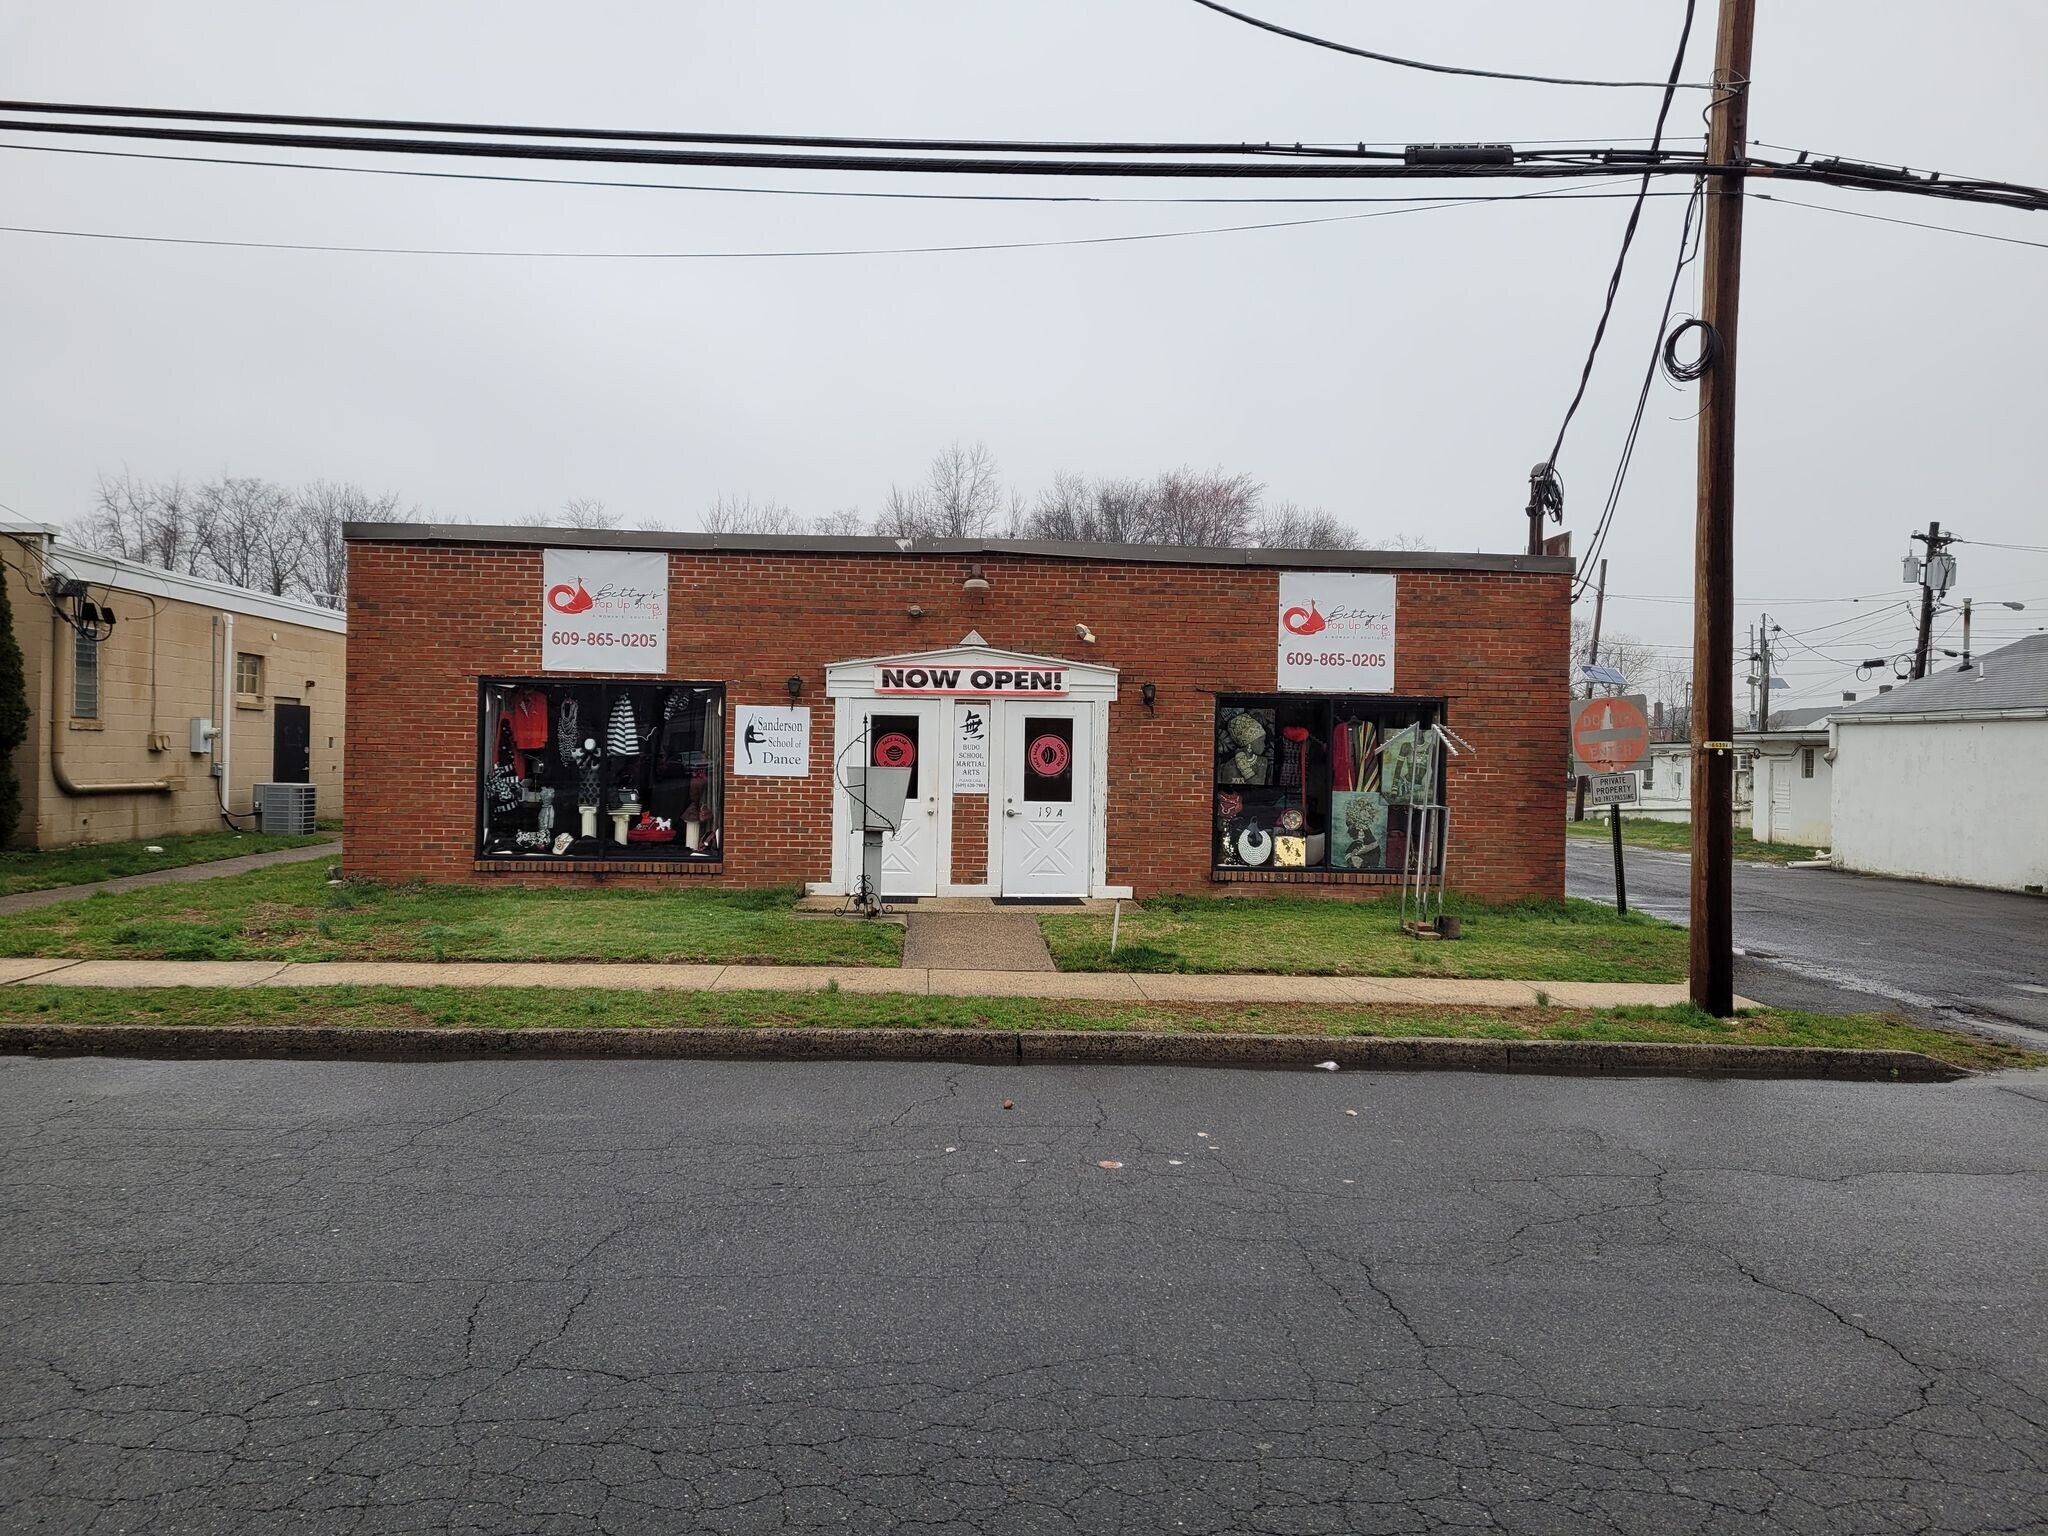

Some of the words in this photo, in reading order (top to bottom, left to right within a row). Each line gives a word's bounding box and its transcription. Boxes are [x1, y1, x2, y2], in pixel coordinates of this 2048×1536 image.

[592, 583, 663, 605] Betty's
[594, 598, 612, 613] Pop
[618, 598, 630, 613] Up
[635, 599, 660, 616] Shop
[1323, 605, 1392, 626] Betty's
[1328, 619, 1344, 635] Pop
[1348, 619, 1361, 635] Up
[1365, 621, 1388, 637] Shop
[551, 631, 658, 648] 609-865-0205
[1286, 652, 1386, 667] 609-865-0205
[881, 669, 961, 689] NOW
[970, 670, 1062, 691] OPEN!
[757, 716, 803, 732] Sanderson
[1583, 714, 1600, 727] DO
[767, 736, 794, 748] School
[794, 739, 802, 749] of
[762, 751, 802, 765] Dance
[1590, 743, 1633, 759] ENTER
[956, 760, 987, 768] MARTIAL
[1599, 776, 1626, 786] PRIVATE
[1594, 795, 1601, 803] NO
[1603, 792, 1635, 801] TRESPASSING
[1596, 785, 1632, 795] PROPERTY
[1038, 806, 1052, 818] 19
[1056, 808, 1063, 817] A
